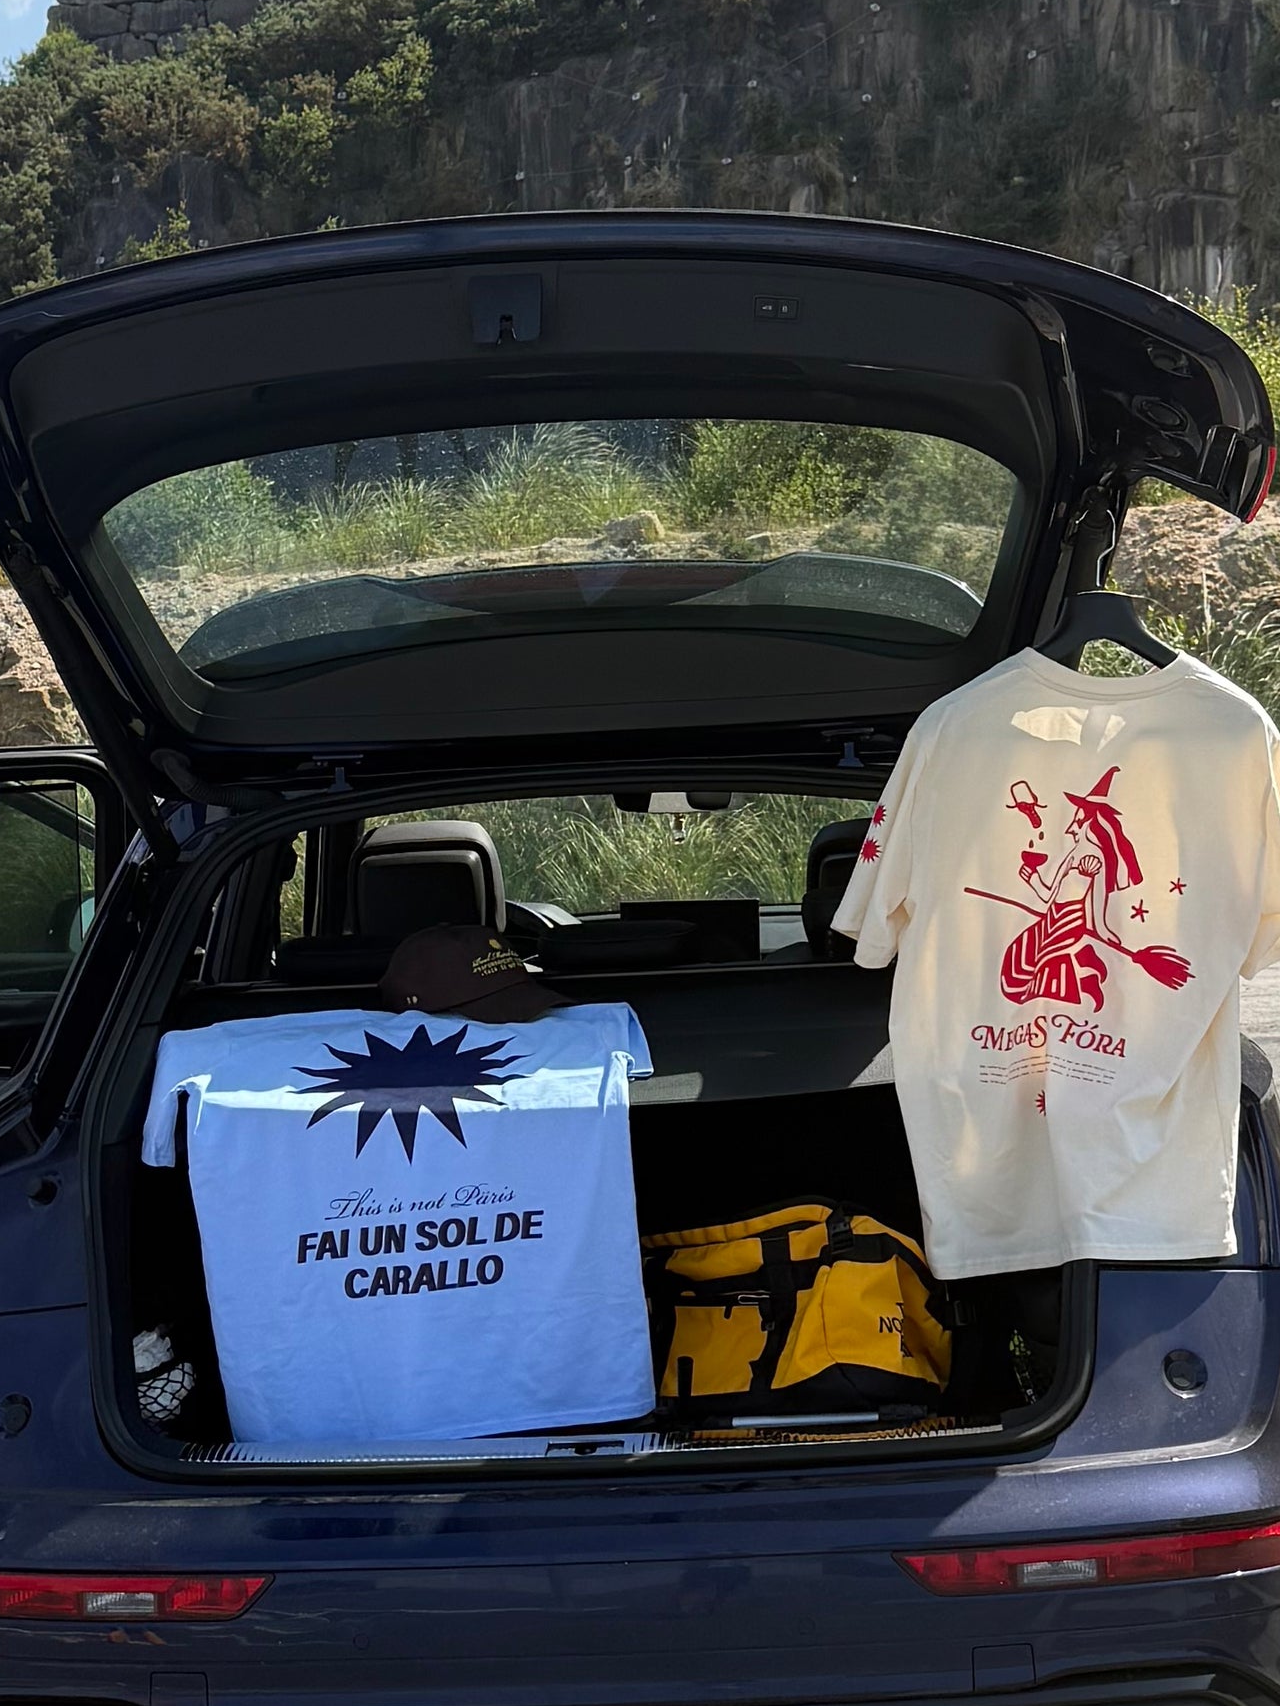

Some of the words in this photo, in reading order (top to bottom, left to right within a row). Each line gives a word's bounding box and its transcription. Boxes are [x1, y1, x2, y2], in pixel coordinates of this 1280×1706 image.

[971, 1015, 1048, 1052] MEGAS
[1051, 1014, 1127, 1058] FÓRA
[324, 1187, 382, 1221] This
[388, 1197, 405, 1215] is
[410, 1191, 448, 1212] not
[297, 1228, 350, 1264] FAI
[358, 1223, 407, 1257] UN
[414, 1216, 488, 1252] SOL
[493, 1209, 545, 1243] DE
[343, 1254, 505, 1299] CARALLO
